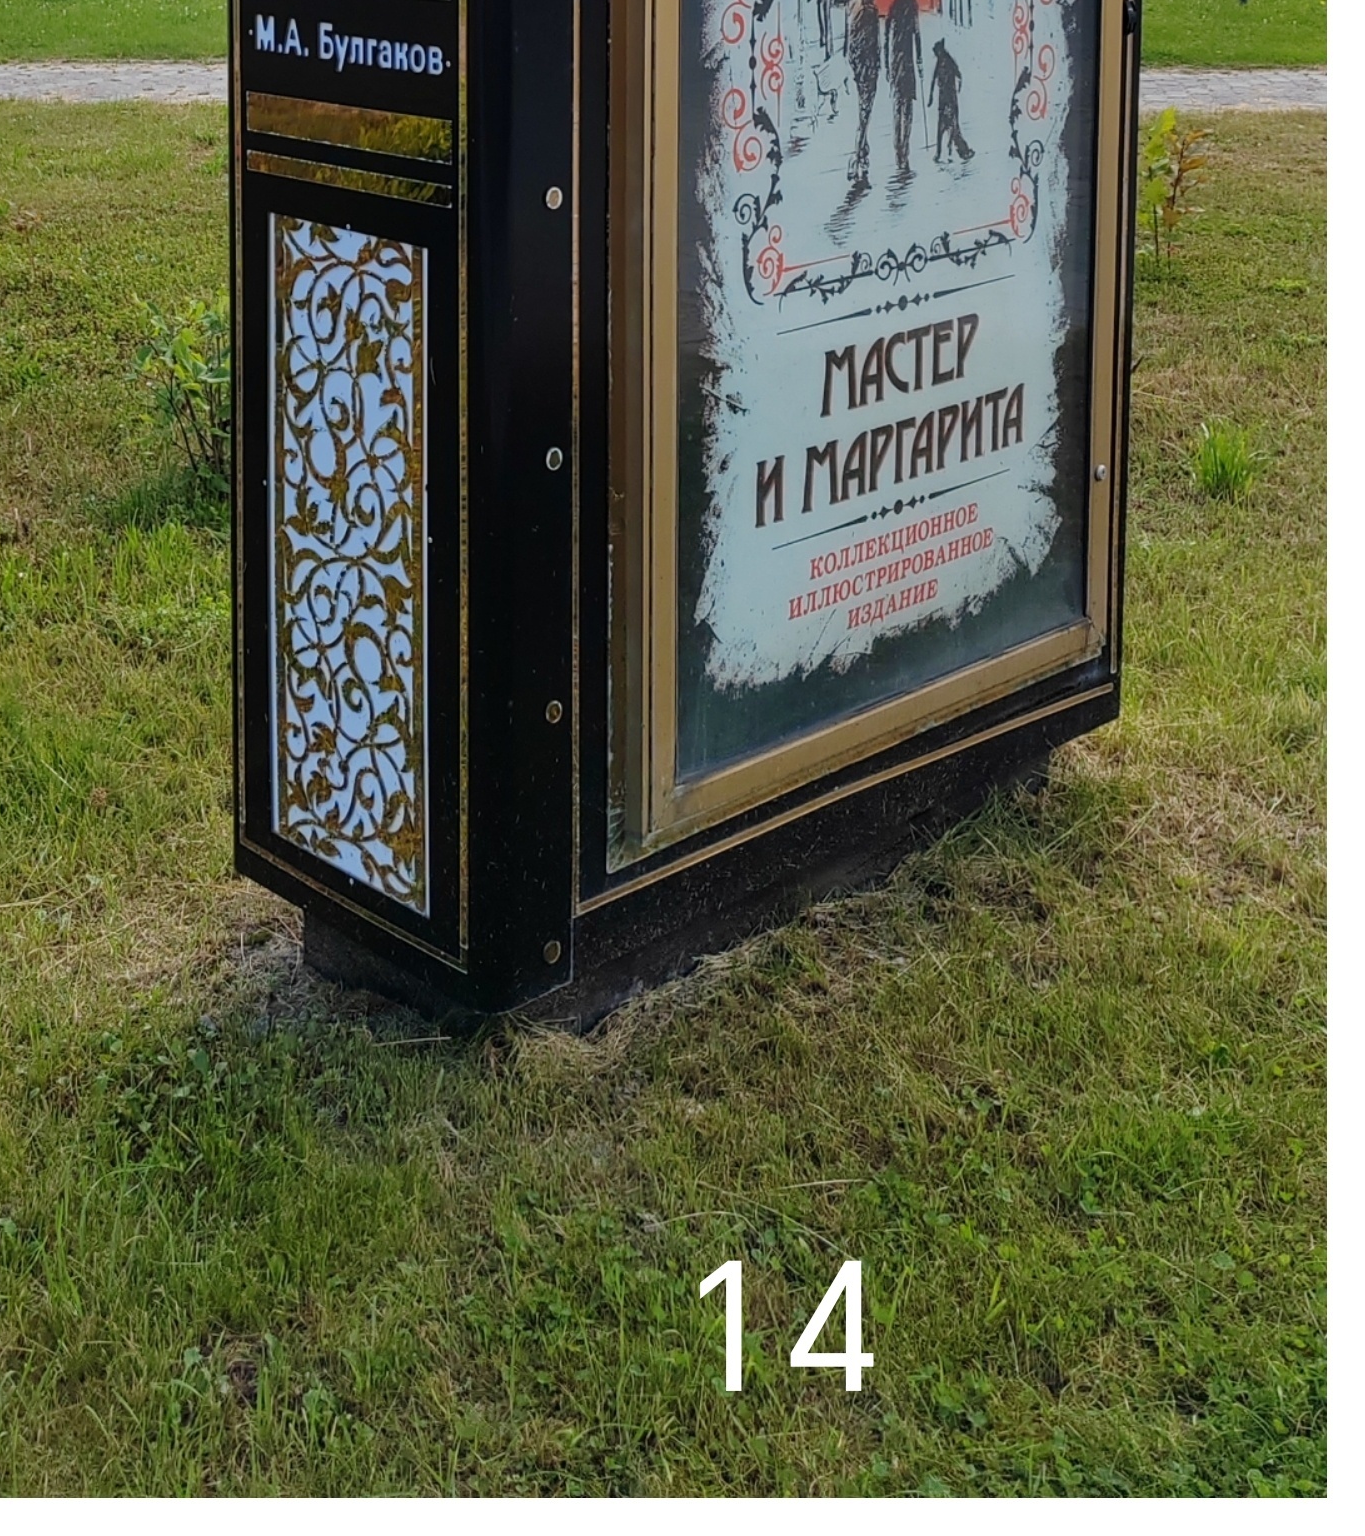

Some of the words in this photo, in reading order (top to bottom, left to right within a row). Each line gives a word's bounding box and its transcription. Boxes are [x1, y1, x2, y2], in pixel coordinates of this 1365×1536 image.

[319, 22, 444, 75] Булгаков
[820, 313, 979, 418] МАСТЕР
[755, 455, 785, 529] И
[801, 383, 1025, 514] МАРГАРИТА
[788, 527, 994, 621] ИЛЛЮСТРИРОВАННОЕ
[809, 502, 979, 581] КОЛЛЕКЦИОННОЕ
[847, 579, 939, 630] ИЗДАНИЕ
